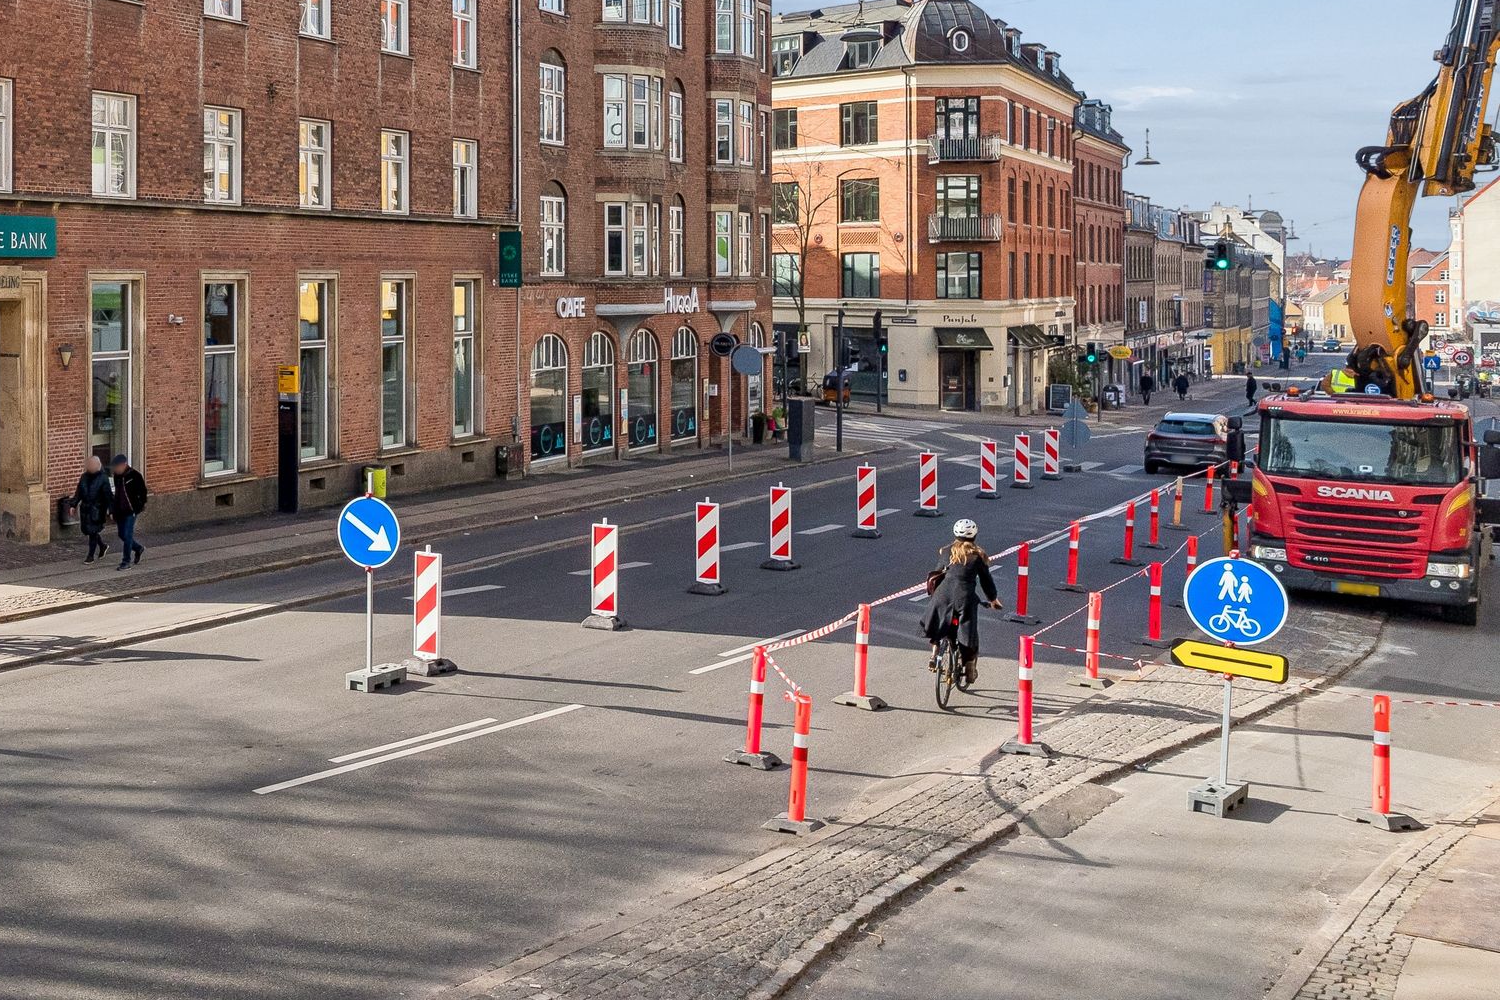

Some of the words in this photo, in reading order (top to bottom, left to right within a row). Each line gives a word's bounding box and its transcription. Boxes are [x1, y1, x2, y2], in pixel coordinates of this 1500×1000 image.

[10, 232, 47, 250] BANK
[557, 297, 586, 318] CAFE
[943, 313, 977, 325] Punjab
[1317, 486, 1394, 502] SCANIA
